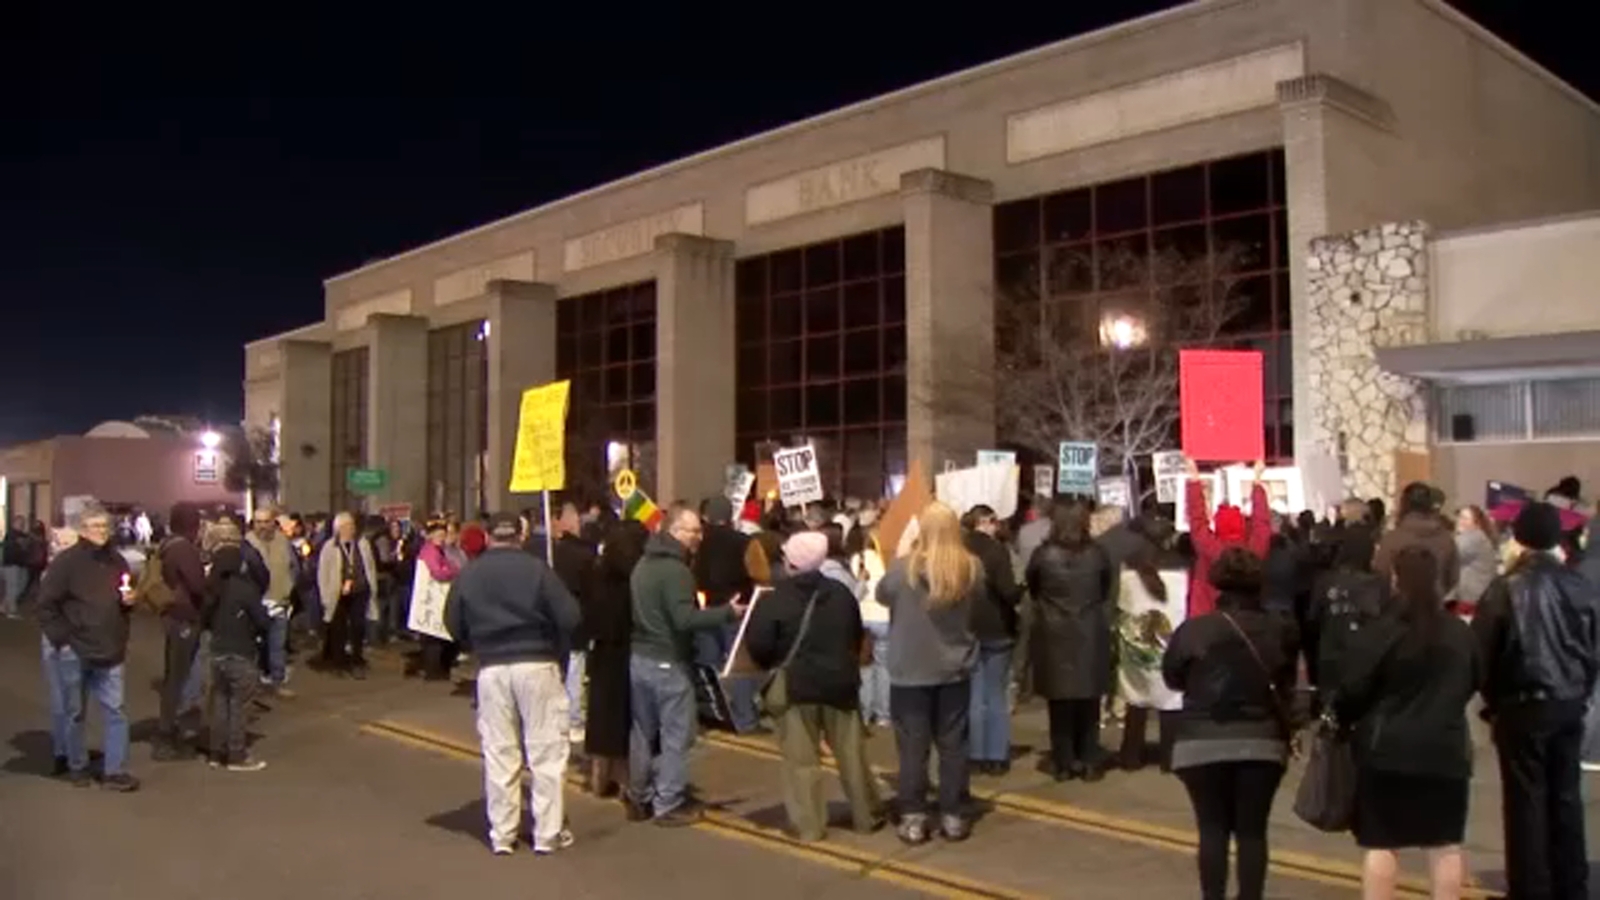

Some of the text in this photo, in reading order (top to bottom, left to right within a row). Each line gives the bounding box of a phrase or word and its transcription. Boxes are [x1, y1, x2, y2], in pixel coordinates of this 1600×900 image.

[797, 159, 881, 207] BANK
[777, 450, 813, 476] STOP
[1062, 445, 1094, 467] STOP
